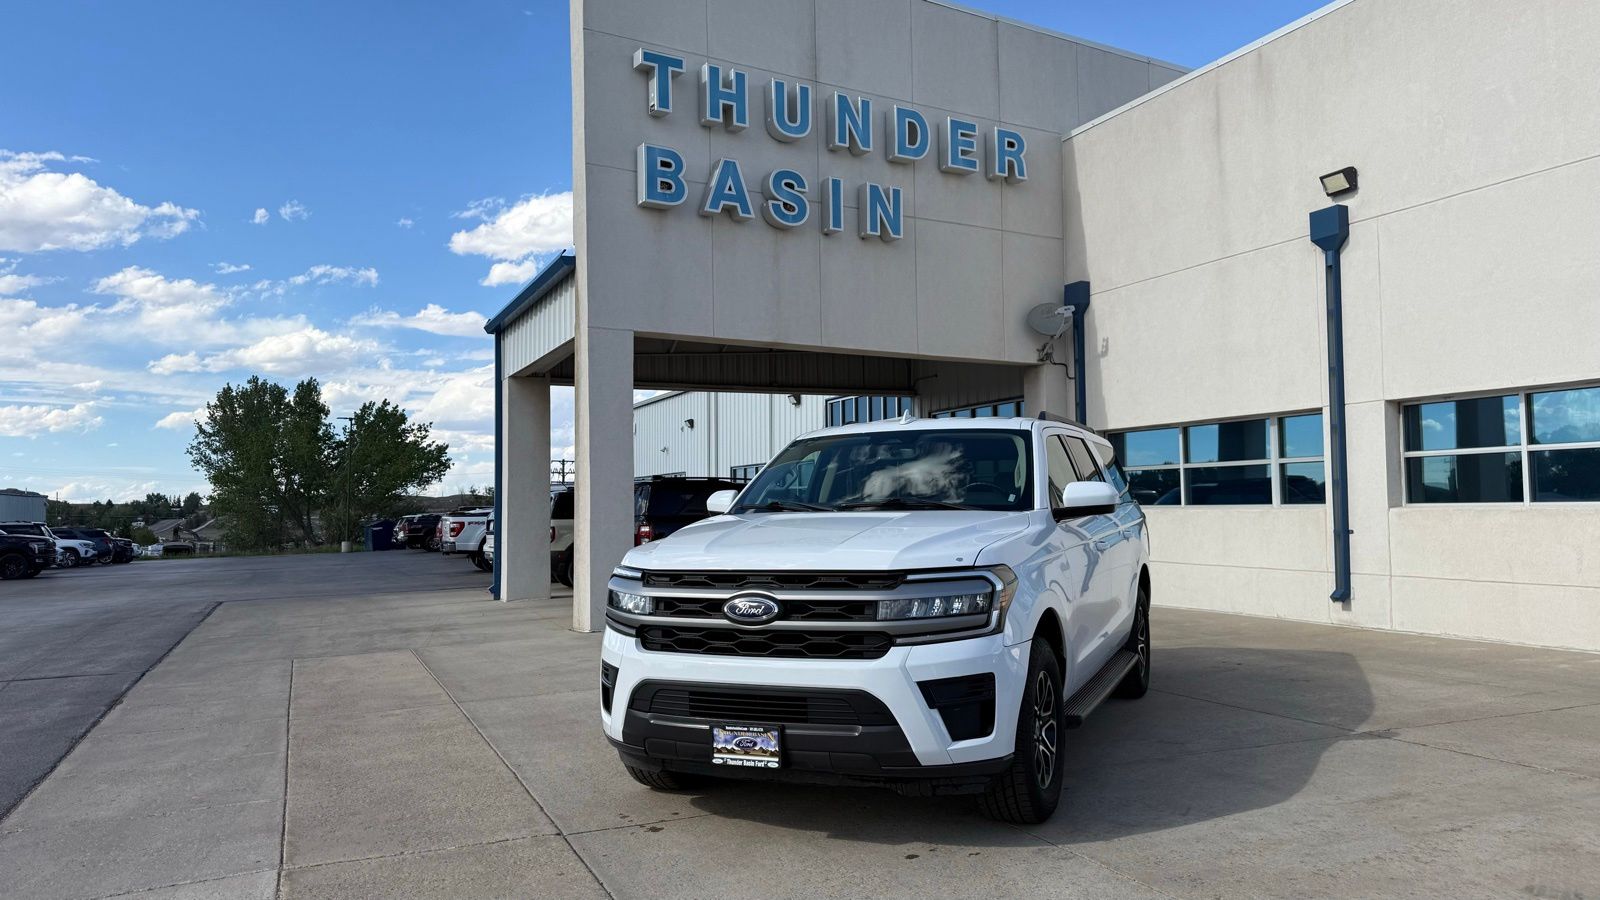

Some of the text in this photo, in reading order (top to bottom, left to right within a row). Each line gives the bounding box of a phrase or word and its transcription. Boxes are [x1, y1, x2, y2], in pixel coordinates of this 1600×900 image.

[633, 47, 1029, 184] THUNDER
[637, 142, 904, 240] BASIN
[735, 601, 765, 615] Ford
[736, 739, 754, 747] Ford
[743, 759, 754, 767] Basin
